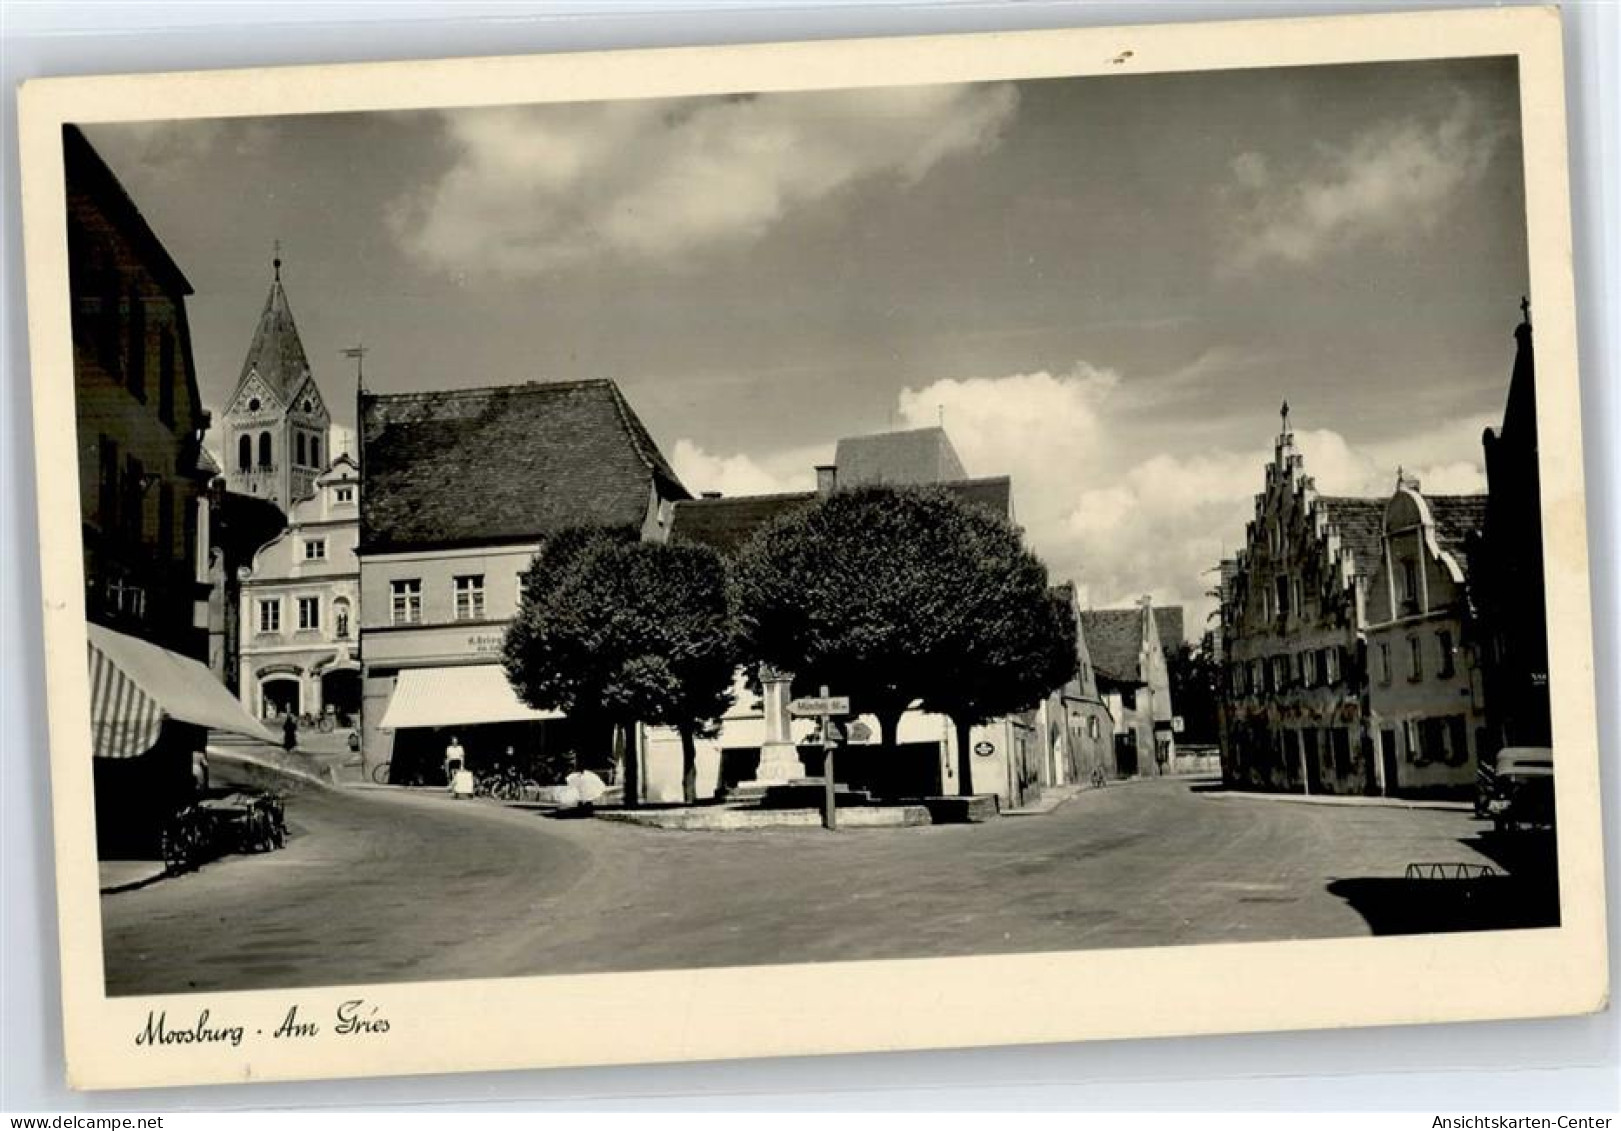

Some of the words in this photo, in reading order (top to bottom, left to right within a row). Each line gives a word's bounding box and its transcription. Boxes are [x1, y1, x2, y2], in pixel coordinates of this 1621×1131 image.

[135, 1009, 244, 1047] Moosburg
[273, 1004, 319, 1038] Am
[334, 999, 390, 1034] Gries
